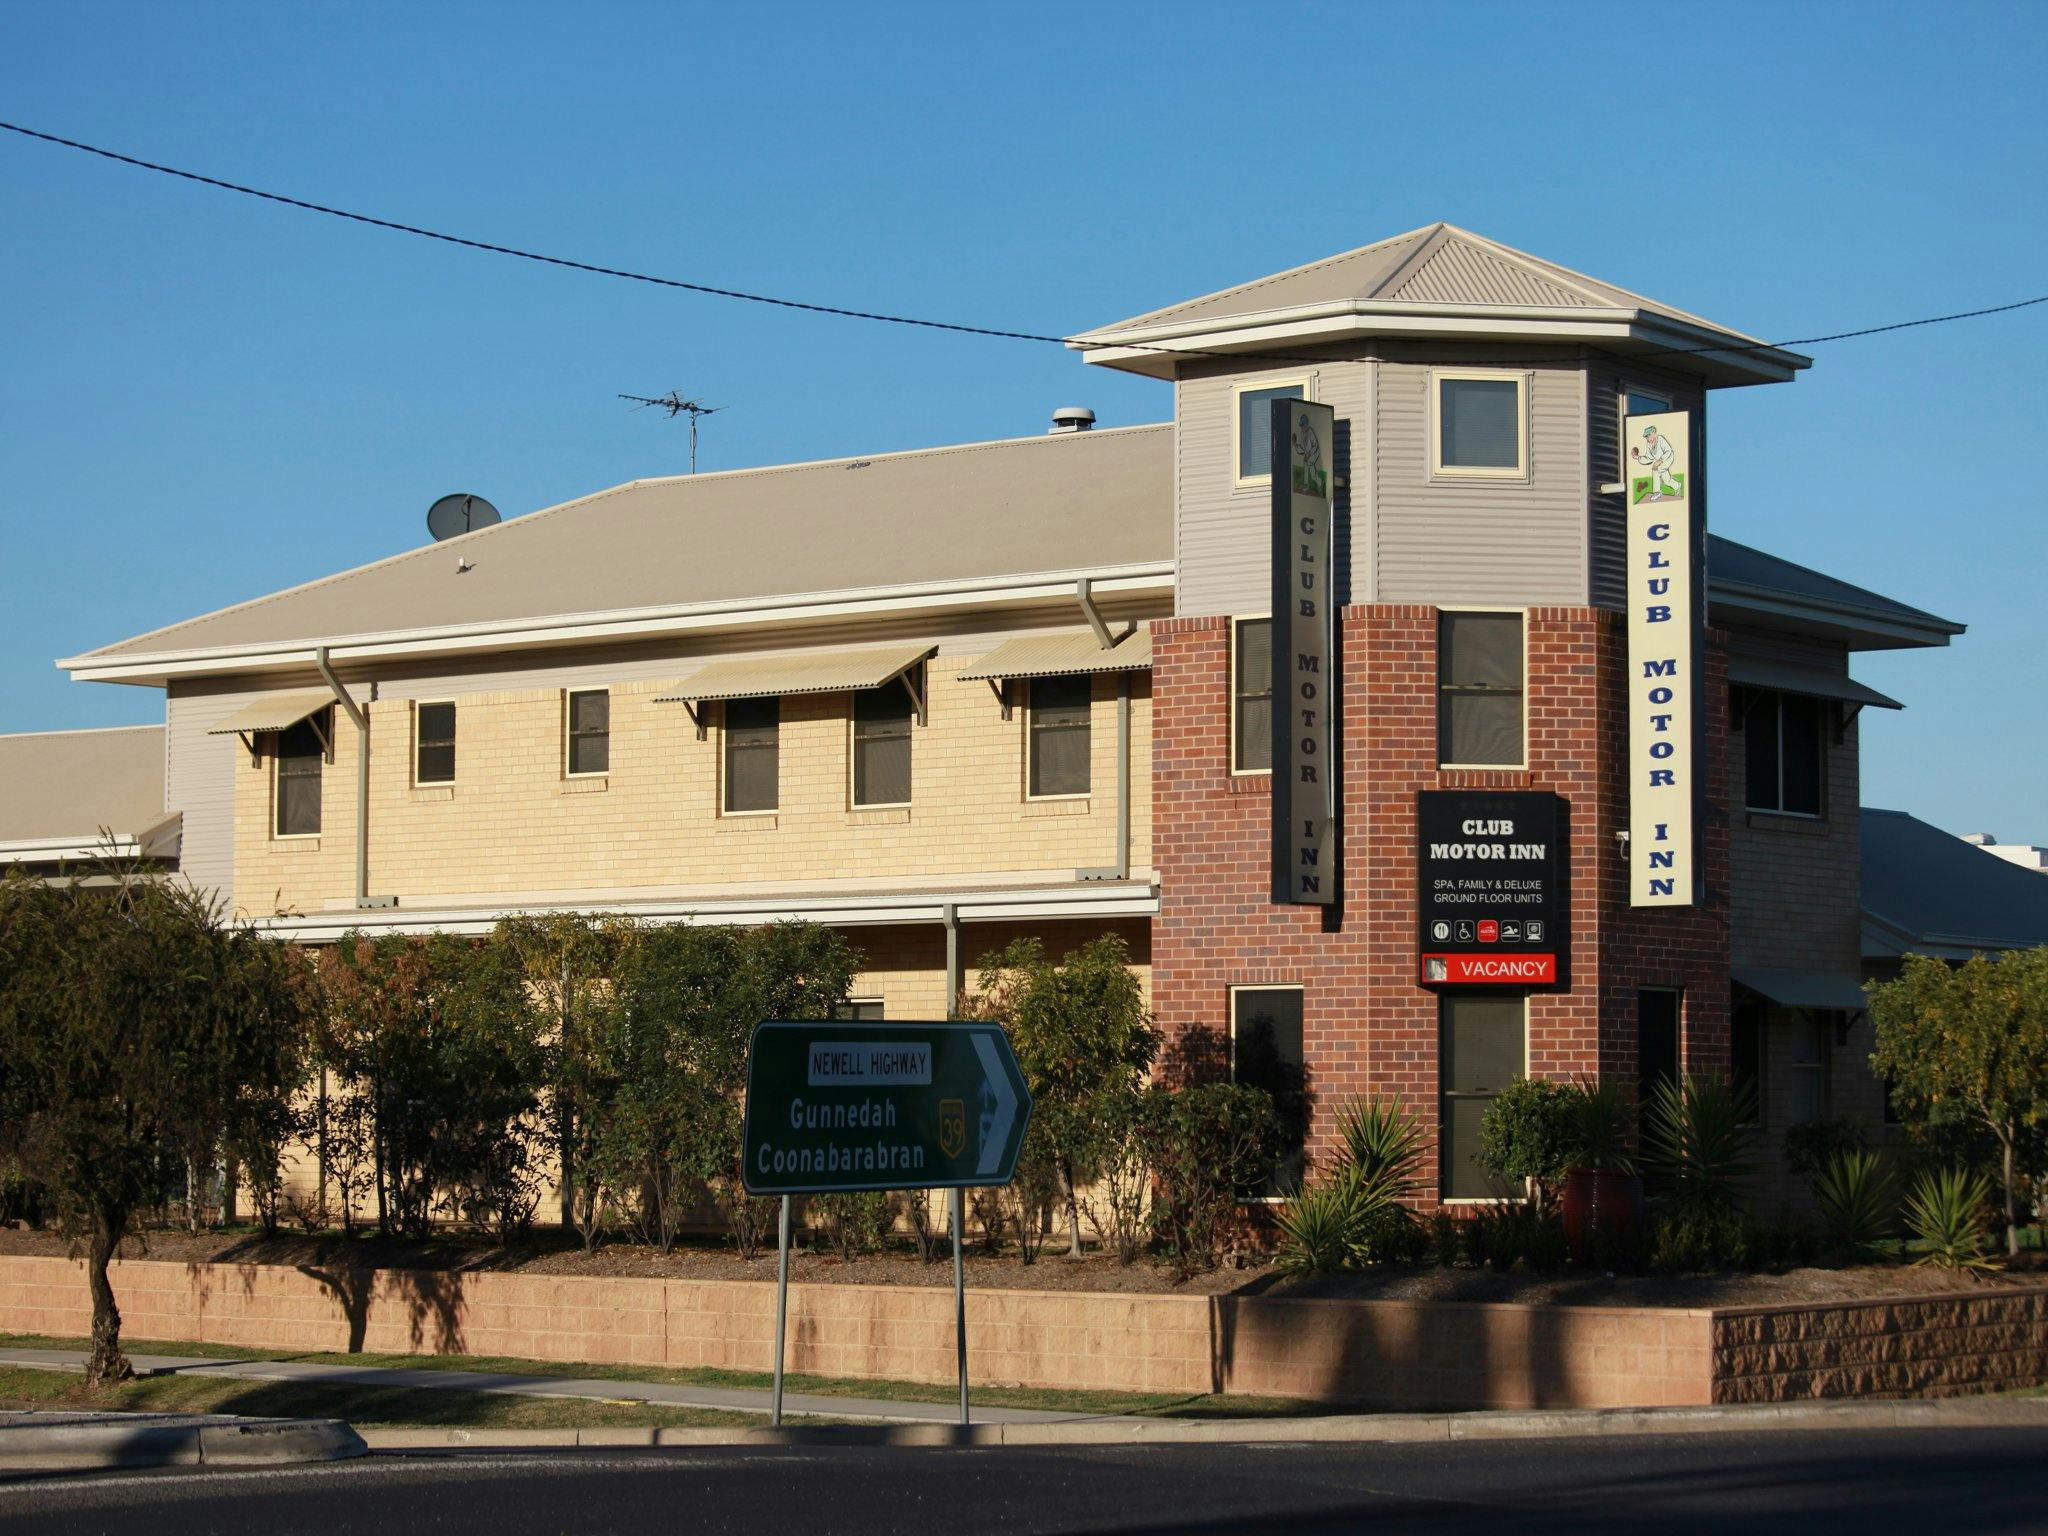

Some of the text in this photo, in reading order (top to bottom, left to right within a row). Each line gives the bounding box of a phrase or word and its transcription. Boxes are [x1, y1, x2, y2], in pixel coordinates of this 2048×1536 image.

[1298, 517, 1320, 894] CLUB MOTOR INN
[1644, 524, 1676, 897] CLUB MOTOR INN
[1462, 820, 1514, 835] CLUB
[1430, 844, 1545, 860] MOTOR INN
[1434, 880, 1542, 891] SPA, FAMILY & DELUXE
[1434, 894, 1543, 903] GROUND FLOOR UNITS
[1461, 961, 1547, 977] VACANCY
[812, 1052, 926, 1076] NEWELL HIGHWAY
[791, 1097, 896, 1129] Gunnedah
[943, 1118, 962, 1148] 39
[757, 1141, 925, 1174] Coonabarabran
